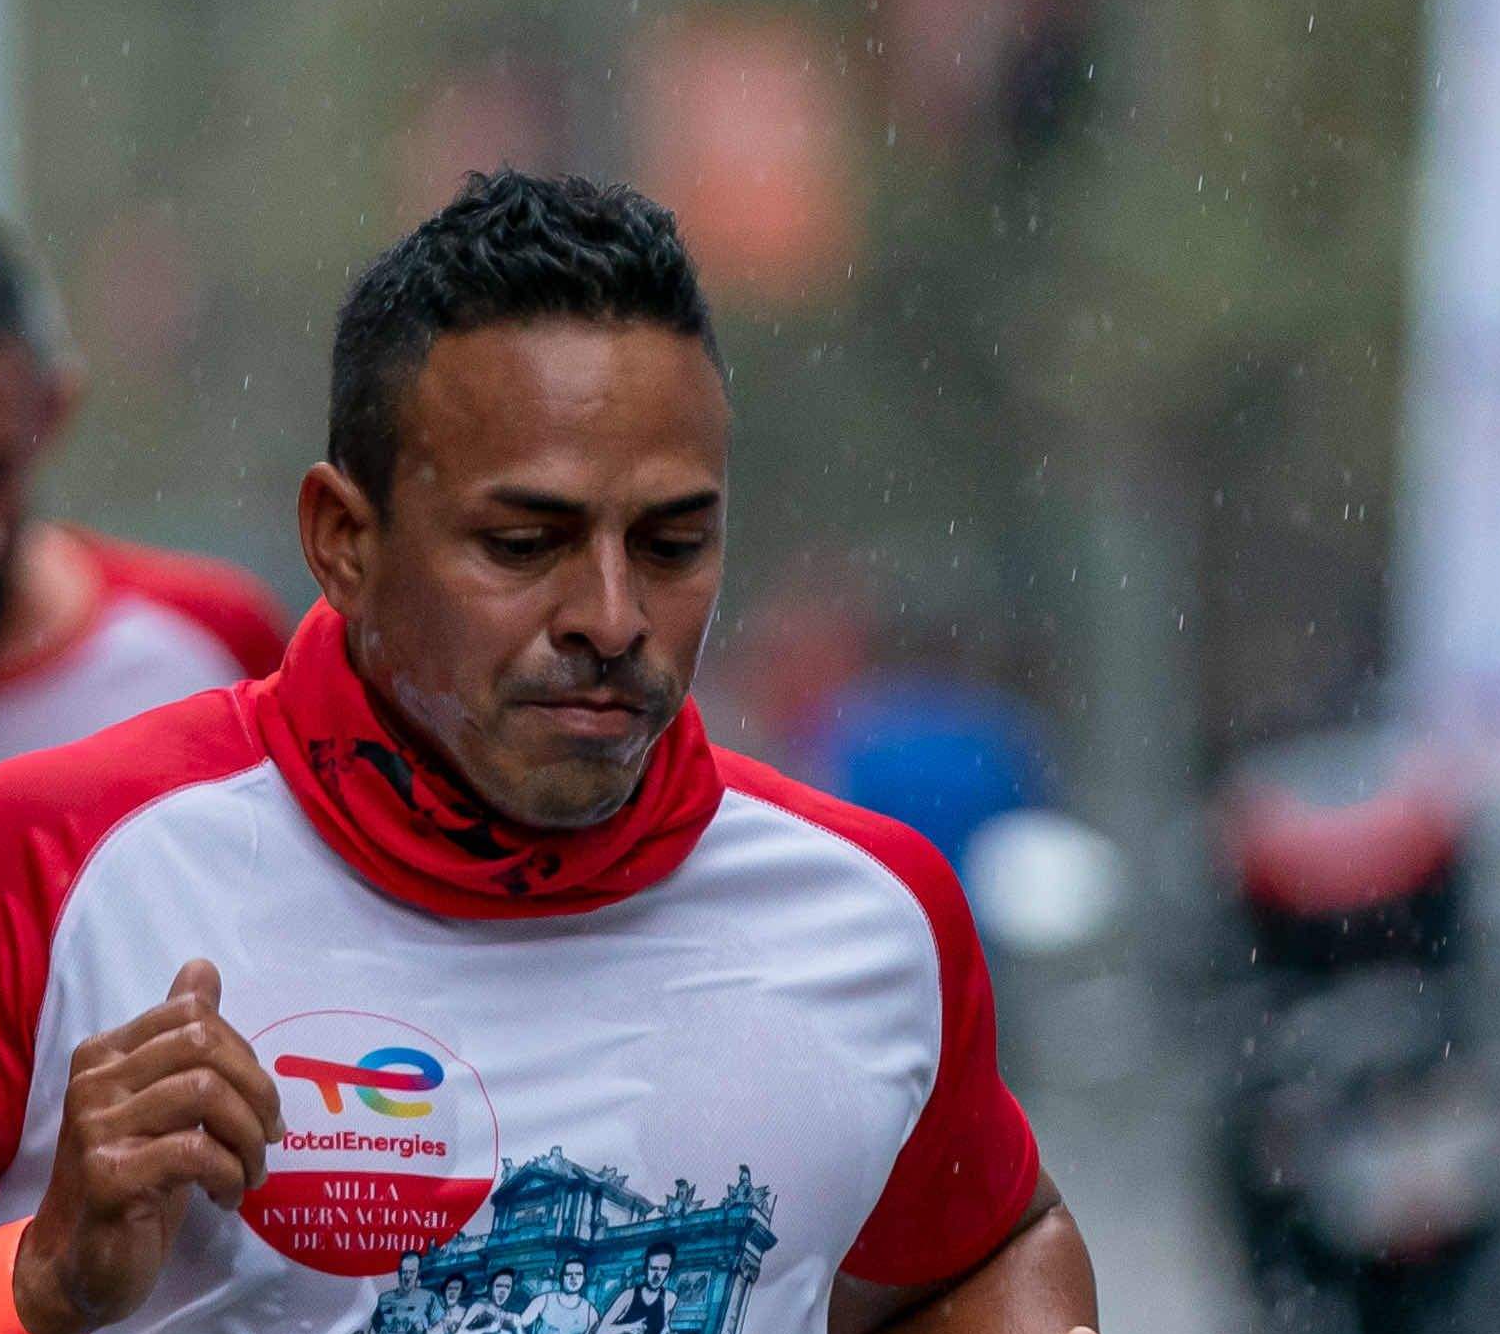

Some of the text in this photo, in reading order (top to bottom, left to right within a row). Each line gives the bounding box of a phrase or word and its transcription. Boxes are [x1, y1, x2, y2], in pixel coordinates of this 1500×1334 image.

[282, 1130, 447, 1158] TotalEnergies
[322, 1180, 399, 1201] MILLA
[294, 1232, 425, 1252] DE MADRID
